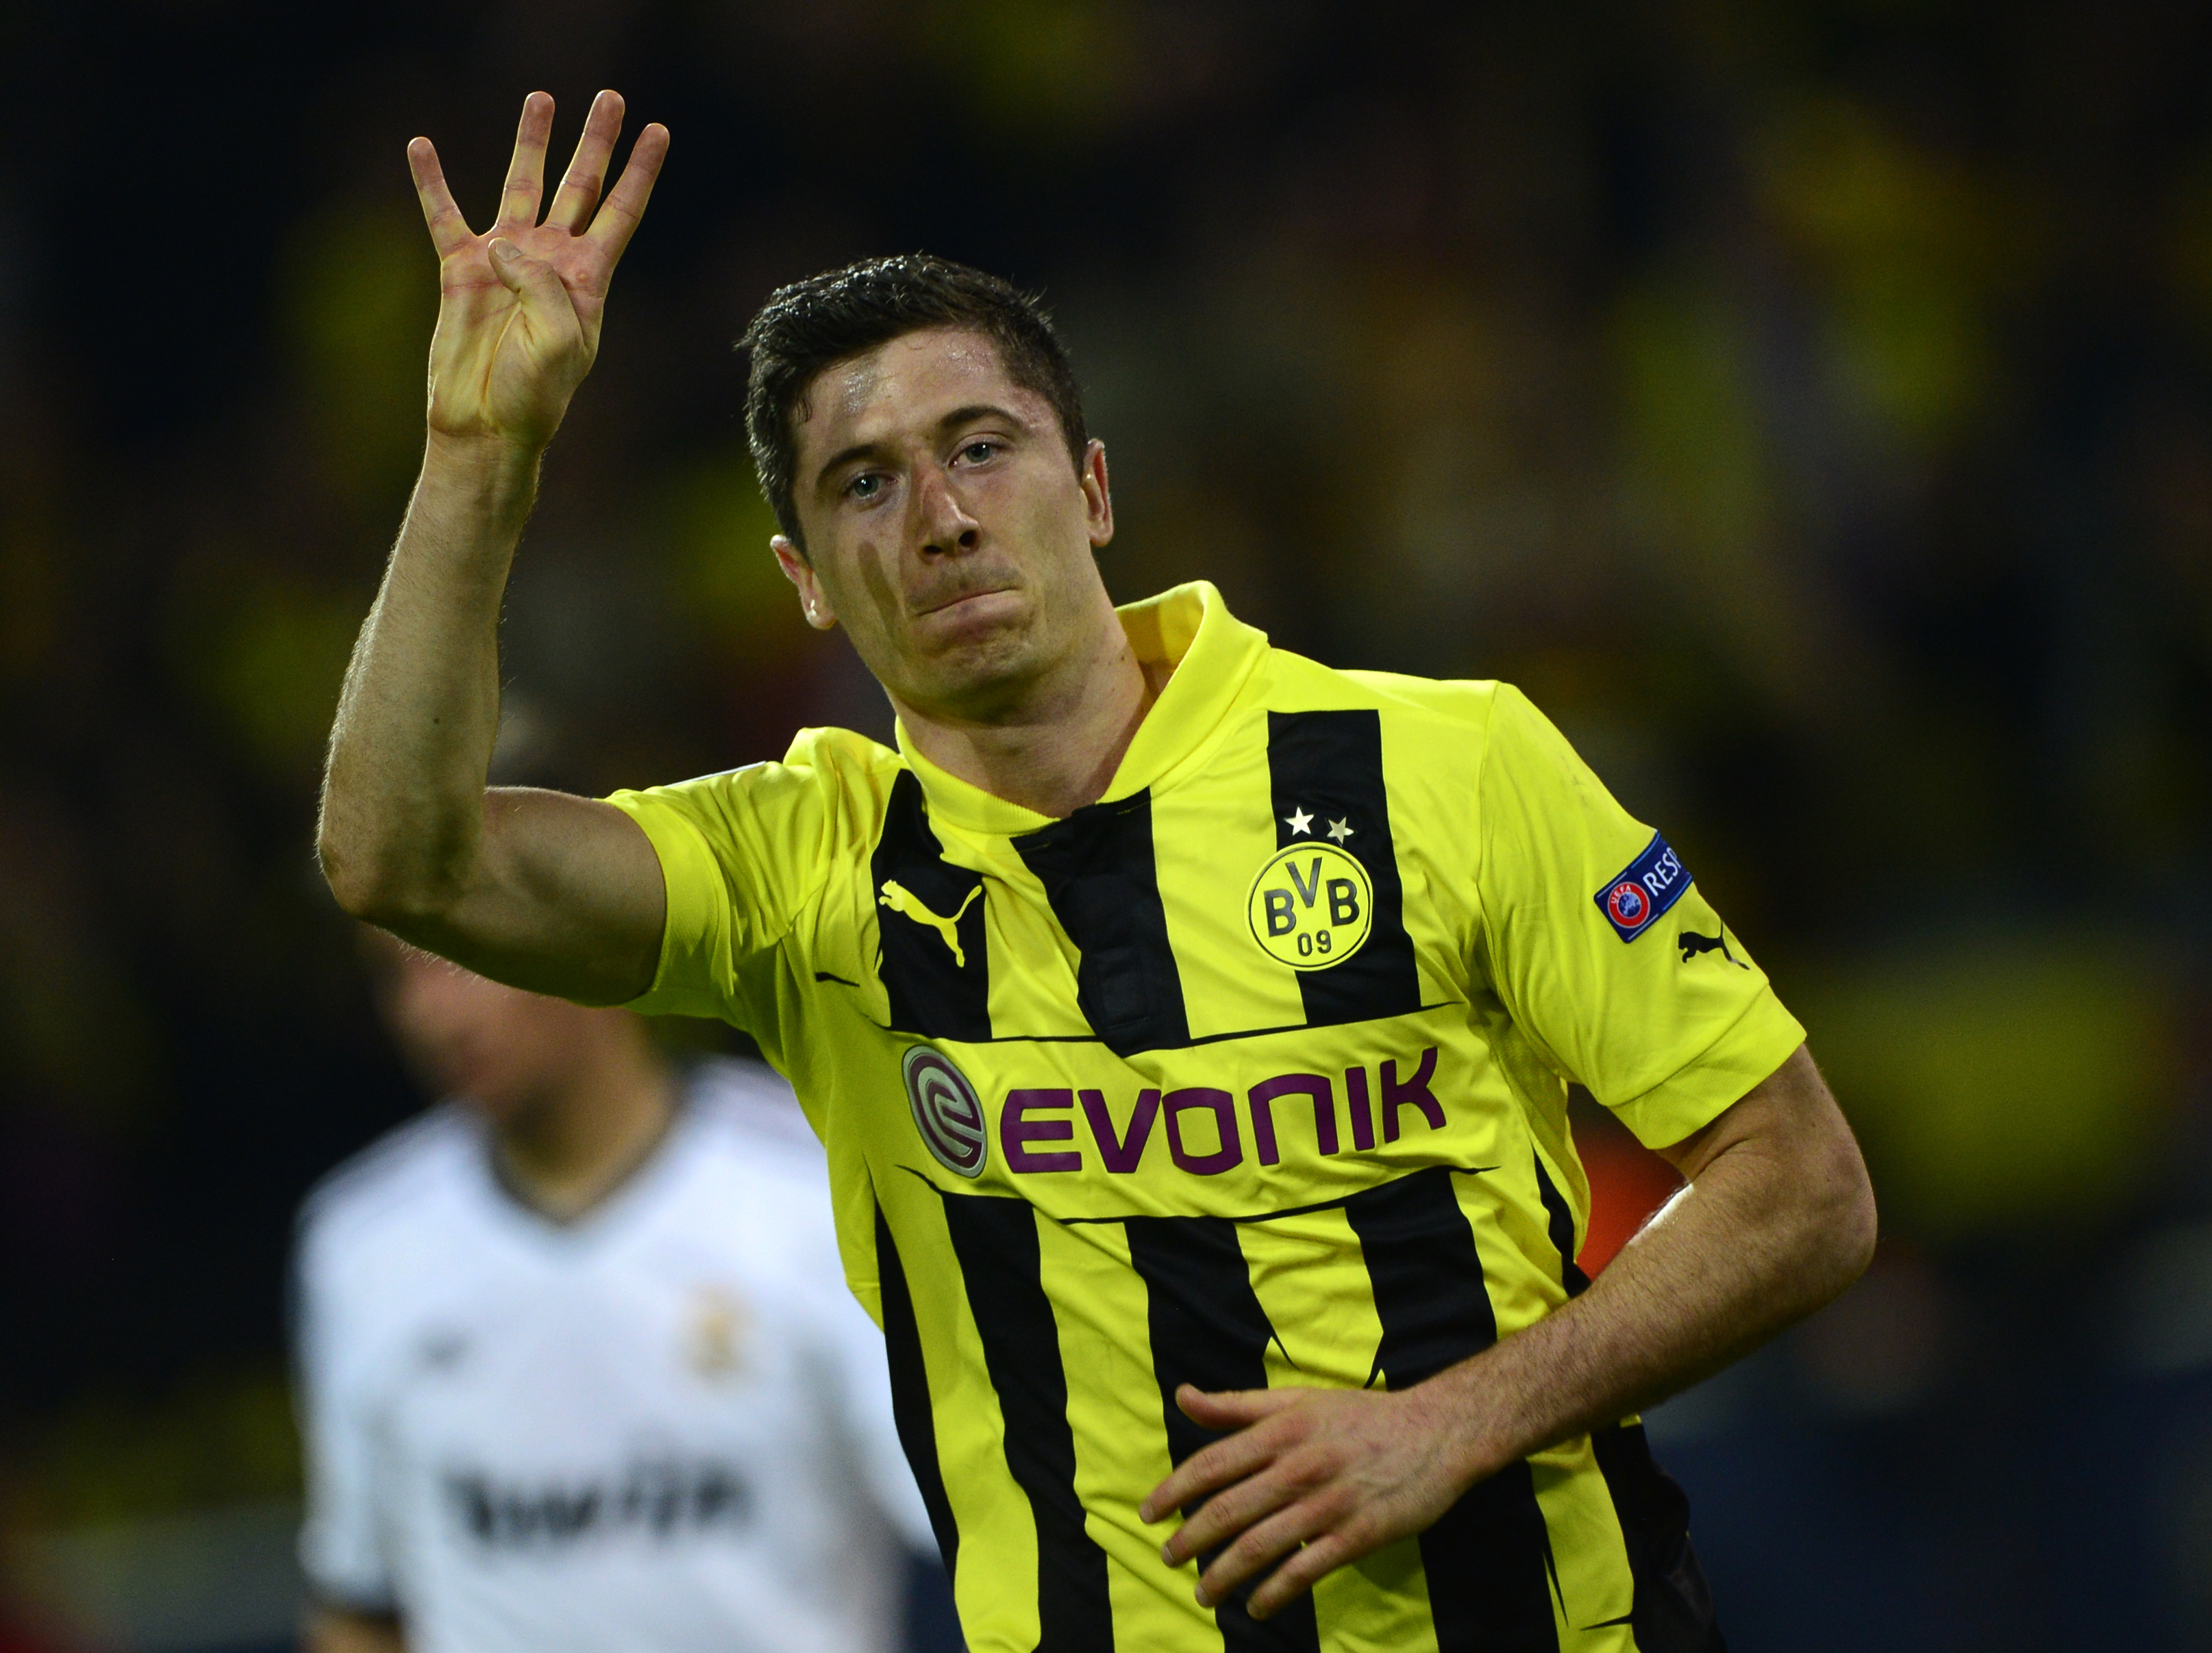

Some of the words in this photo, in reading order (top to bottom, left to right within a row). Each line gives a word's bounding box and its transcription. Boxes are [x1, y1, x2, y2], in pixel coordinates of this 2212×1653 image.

[1264, 856, 1360, 937] BVB
[1611, 884, 1632, 904] UEFA
[1297, 930, 1332, 956] 09
[1000, 1047, 1447, 1176] EVONIK
